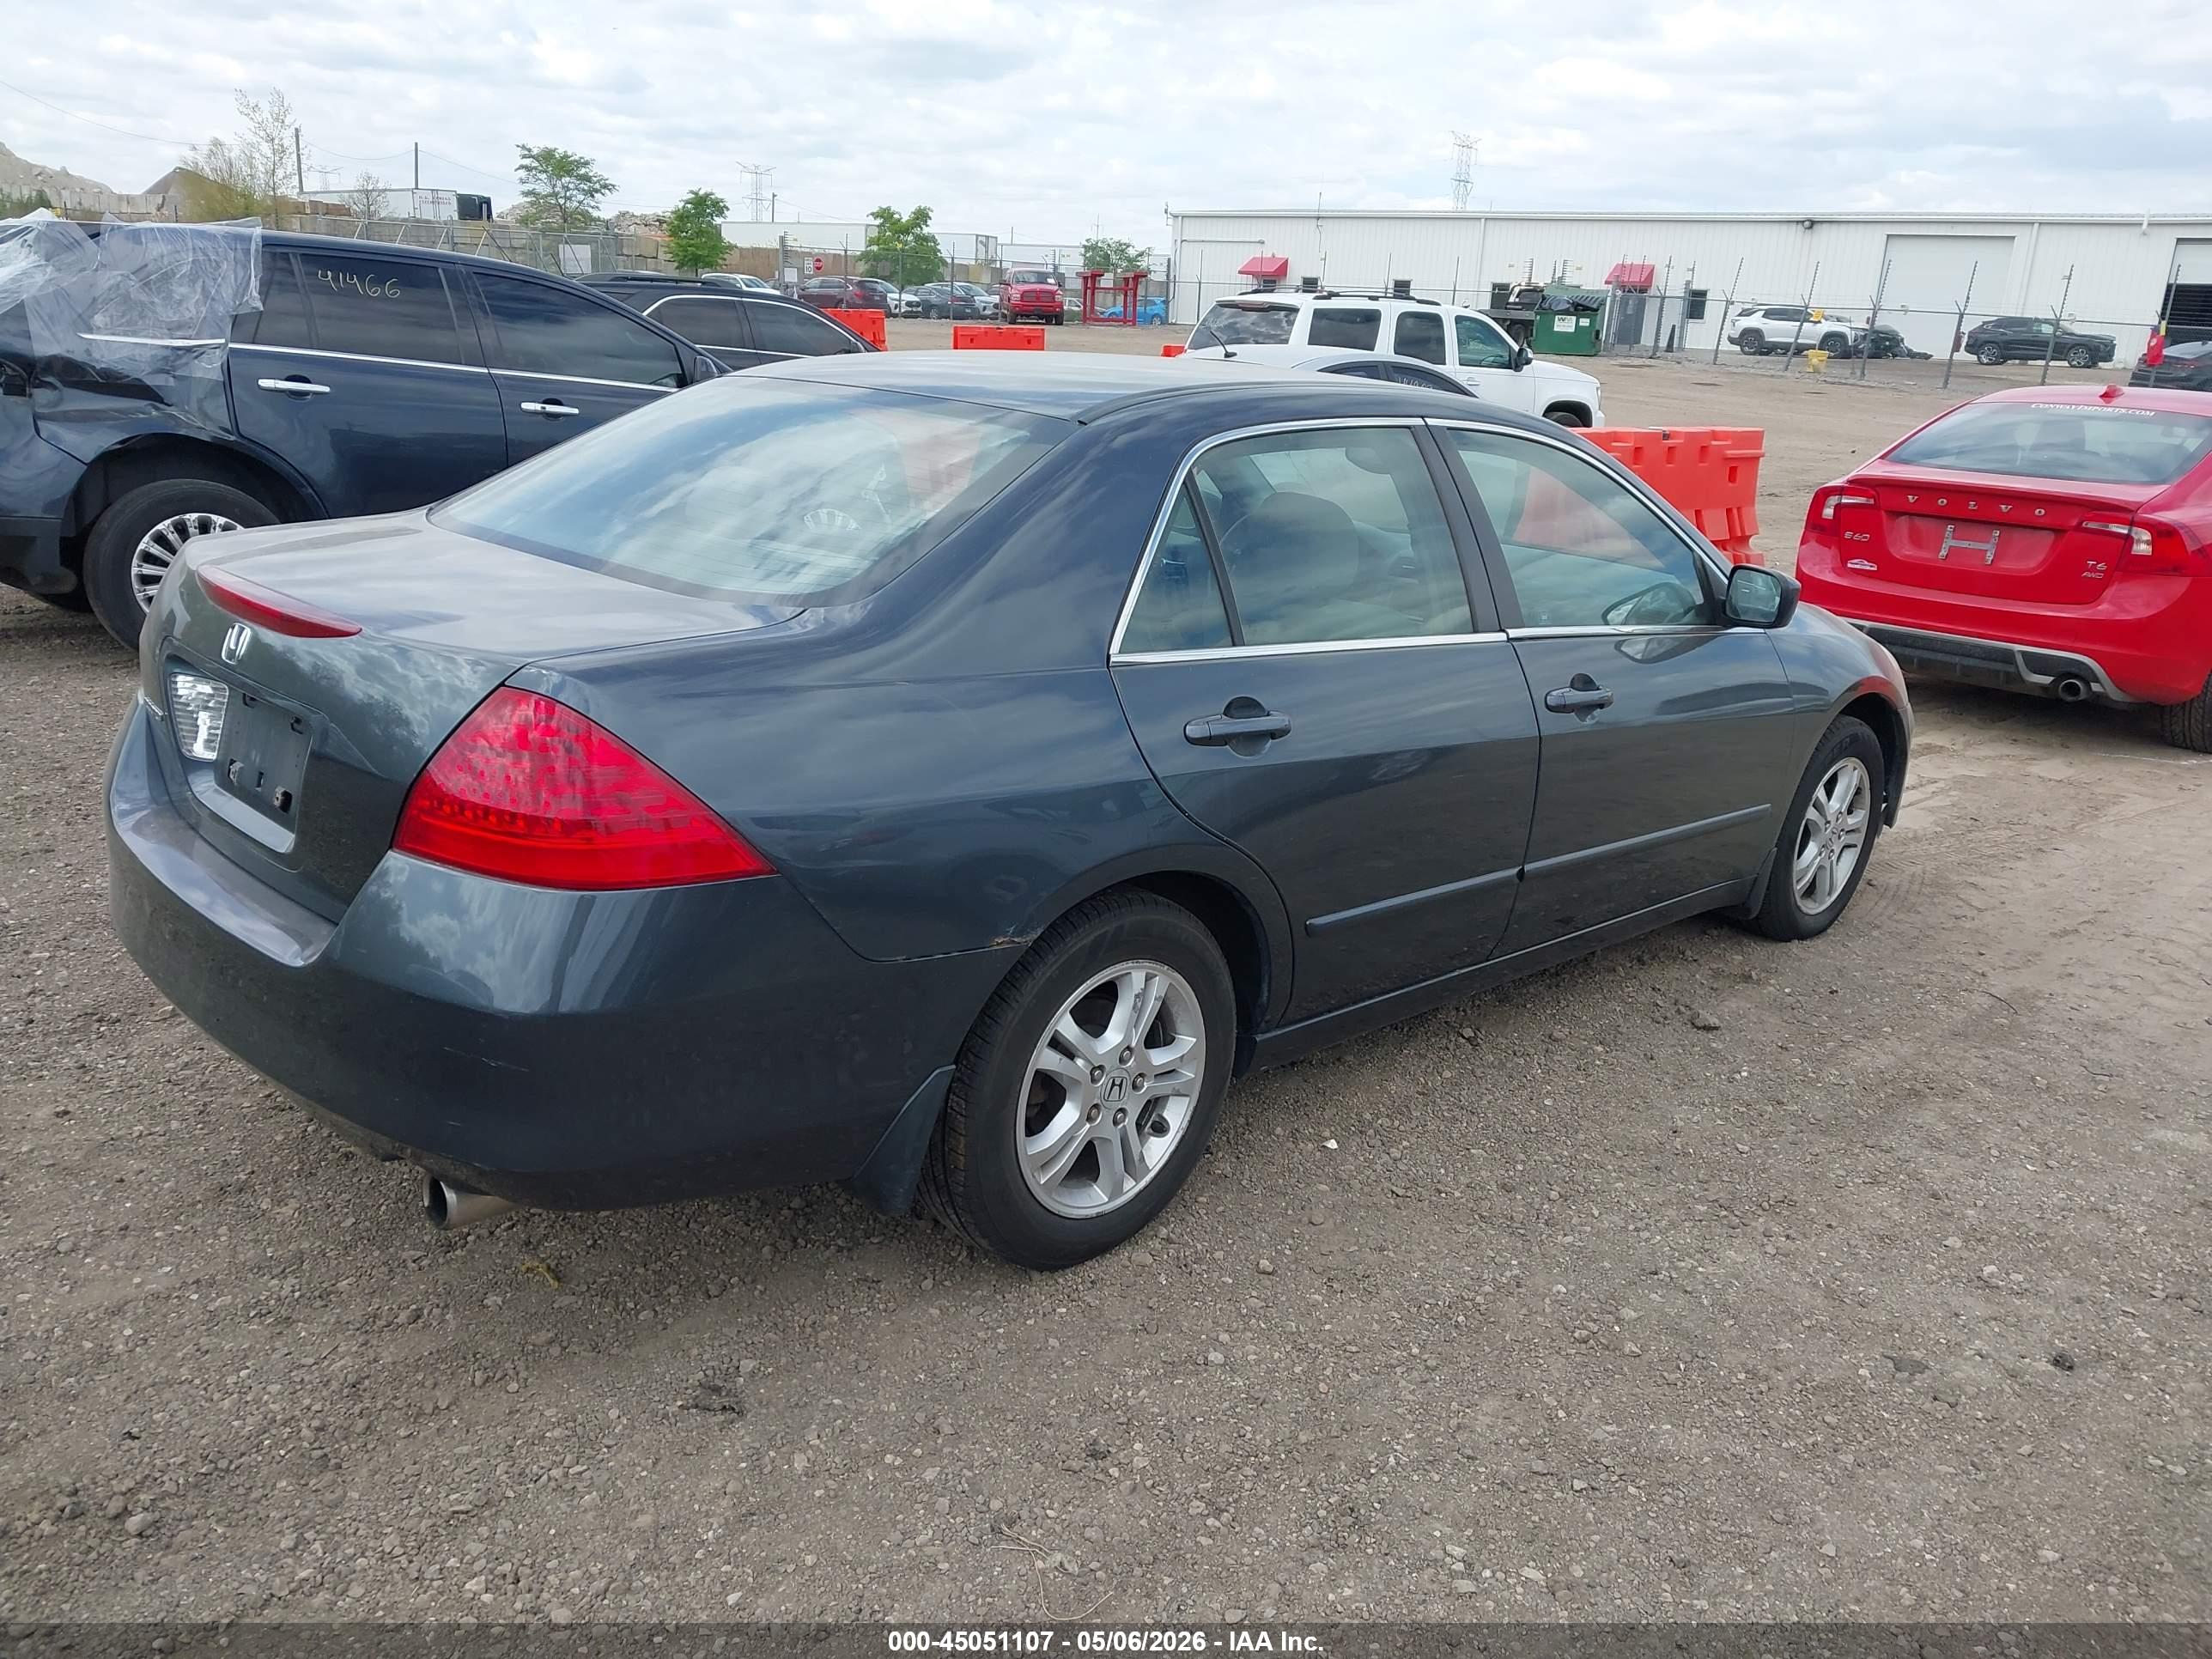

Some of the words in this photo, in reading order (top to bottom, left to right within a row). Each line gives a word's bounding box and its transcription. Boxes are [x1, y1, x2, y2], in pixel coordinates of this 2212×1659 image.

[318, 270, 400, 298] 41466
[1906, 495, 2046, 516] VOLVO
[1844, 531, 1870, 542] S60
[2087, 560, 2107, 570] T6
